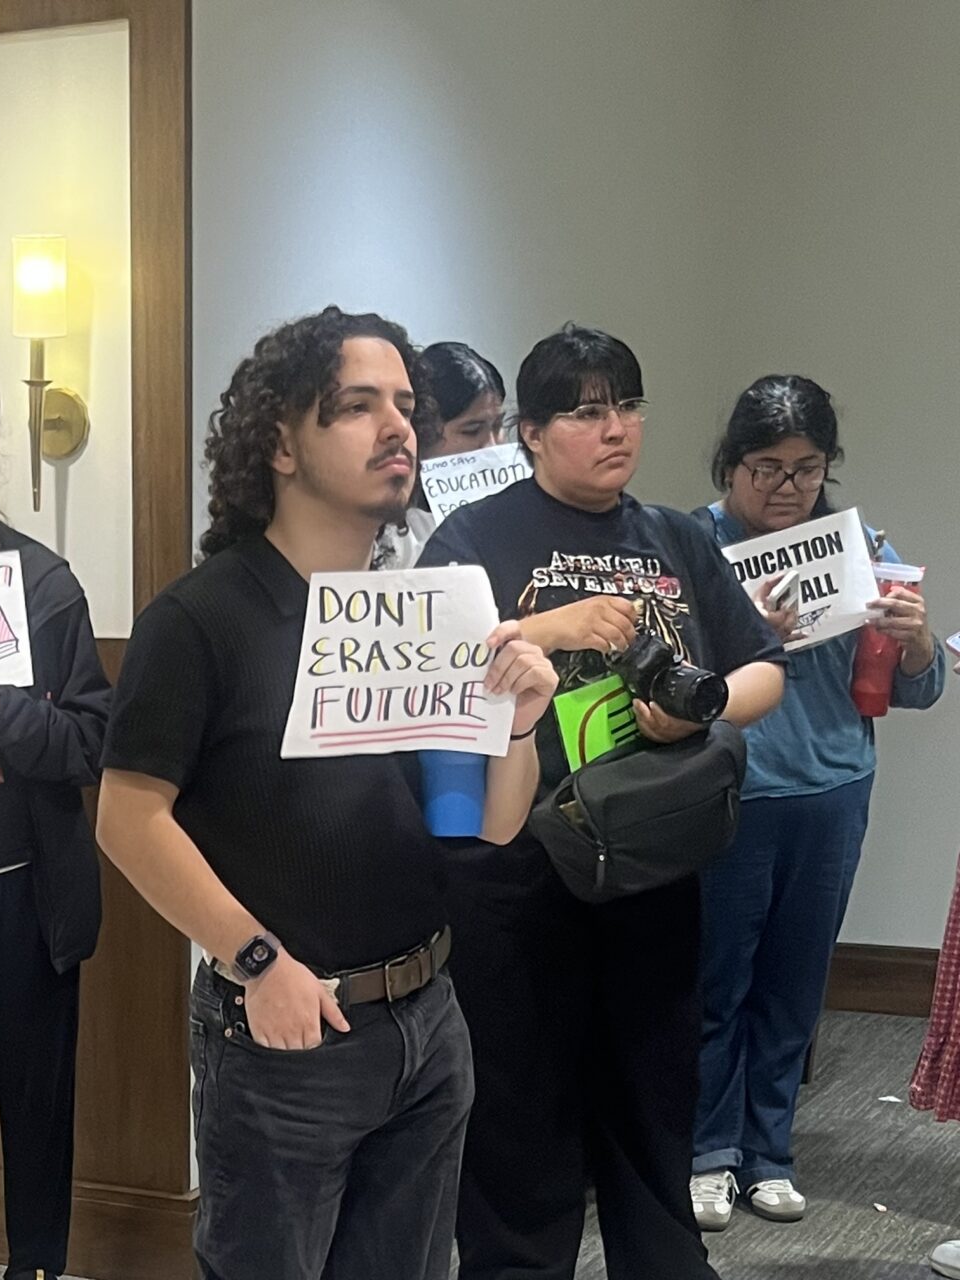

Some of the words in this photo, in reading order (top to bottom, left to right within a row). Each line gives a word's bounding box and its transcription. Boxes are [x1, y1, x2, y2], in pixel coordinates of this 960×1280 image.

[425, 463, 526, 498] EDUCATION
[730, 531, 844, 582] DUCATION
[800, 573, 839, 603] ALL
[319, 586, 445, 634] DON'T
[308, 637, 441, 676] ERASE
[450, 642, 492, 669] OU
[311, 681, 488, 729] FUTURE
